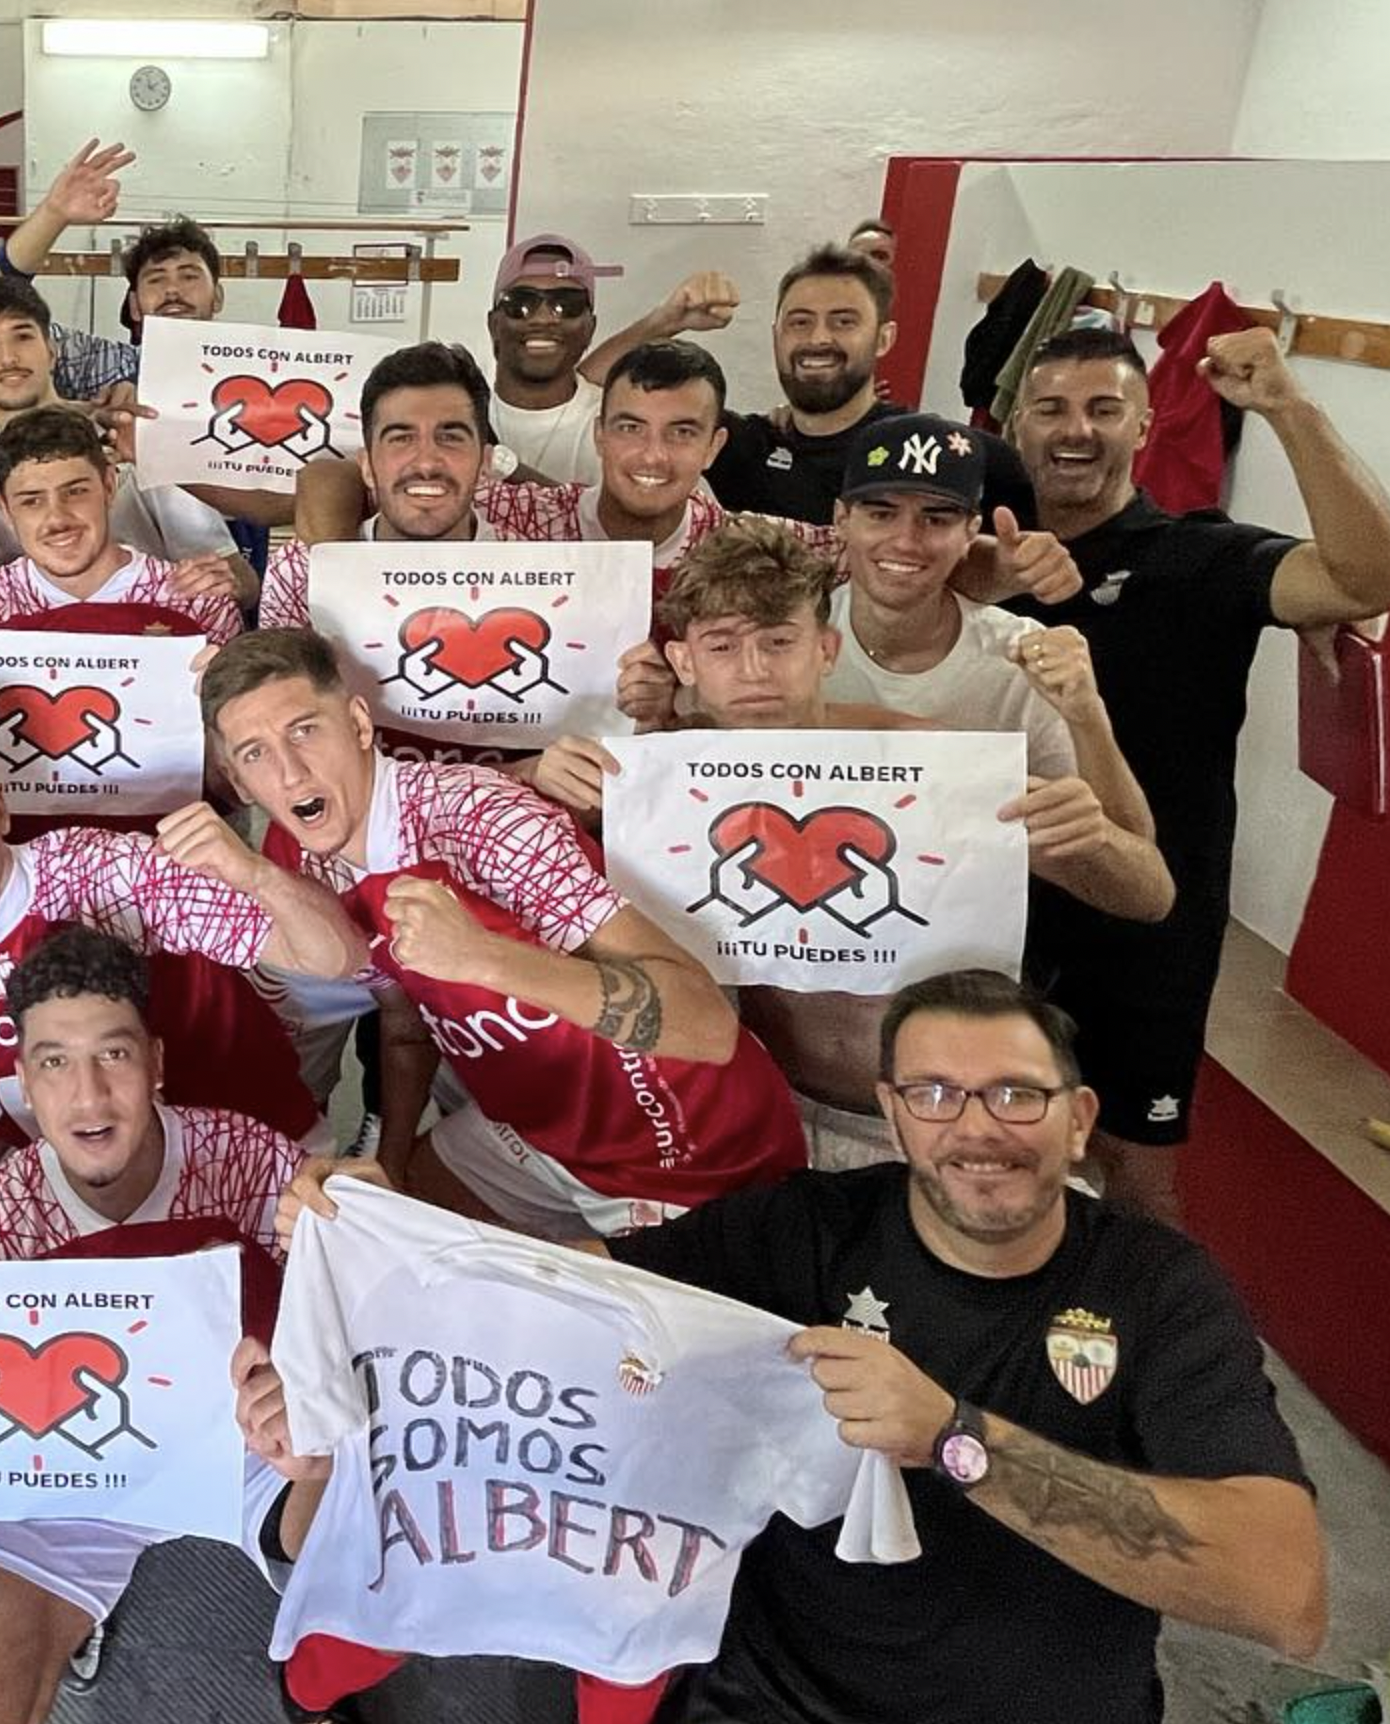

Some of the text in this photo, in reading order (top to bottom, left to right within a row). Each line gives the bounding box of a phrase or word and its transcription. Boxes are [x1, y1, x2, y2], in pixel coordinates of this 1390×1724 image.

[200, 344, 354, 365] TODOS CON ALBERT
[245, 464, 298, 478] PUEDE
[382, 571, 576, 586] TODOS CON ALBERT
[33, 656, 70, 669] CON
[74, 657, 140, 670] ALBERT
[446, 709, 519, 724] PUEDES
[523, 712, 542, 724] !!!
[686, 761, 924, 782] TODOS CON ALBERT
[35, 782, 99, 795] PUEDES
[103, 784, 120, 795] !!!
[773, 944, 867, 963] PUEDES
[873, 949, 897, 963] !!!
[5, 1293, 57, 1310] CON
[64, 1292, 155, 1310] ALBERT
[351, 1346, 600, 1430] TODOS
[369, 1416, 607, 1498] SOMOS
[8, 1471, 98, 1489] PUEDES
[105, 1473, 127, 1488] !!!
[368, 1478, 728, 1598] ALBERT
